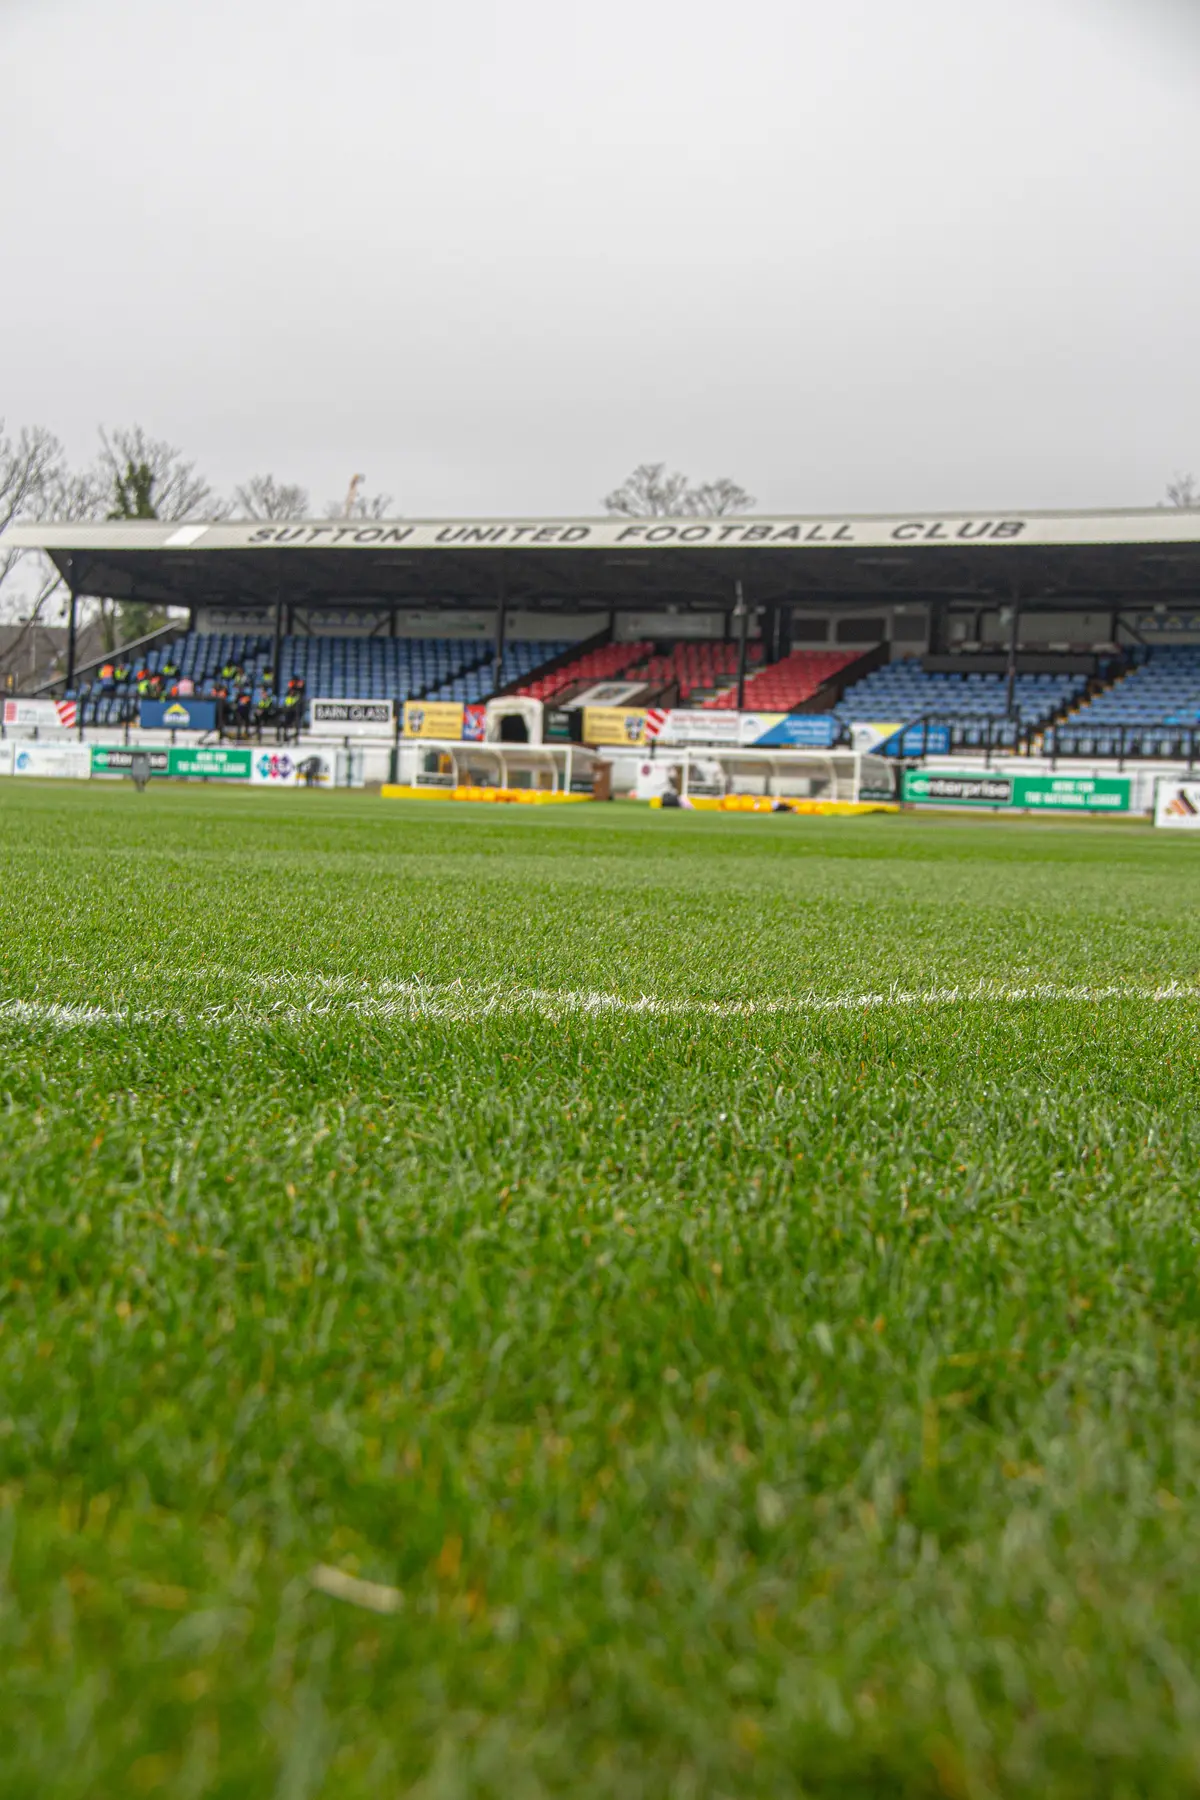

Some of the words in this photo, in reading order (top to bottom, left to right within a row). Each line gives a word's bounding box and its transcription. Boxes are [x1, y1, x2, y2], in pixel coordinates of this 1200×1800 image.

[248, 526, 415, 544] SUTTON
[434, 526, 592, 543] UNITED
[614, 523, 856, 542] FOOTBALL
[890, 521, 1028, 541] CLUB
[316, 705, 348, 719] BARN
[351, 706, 388, 720] GLASS
[909, 778, 1010, 798] enterprise
